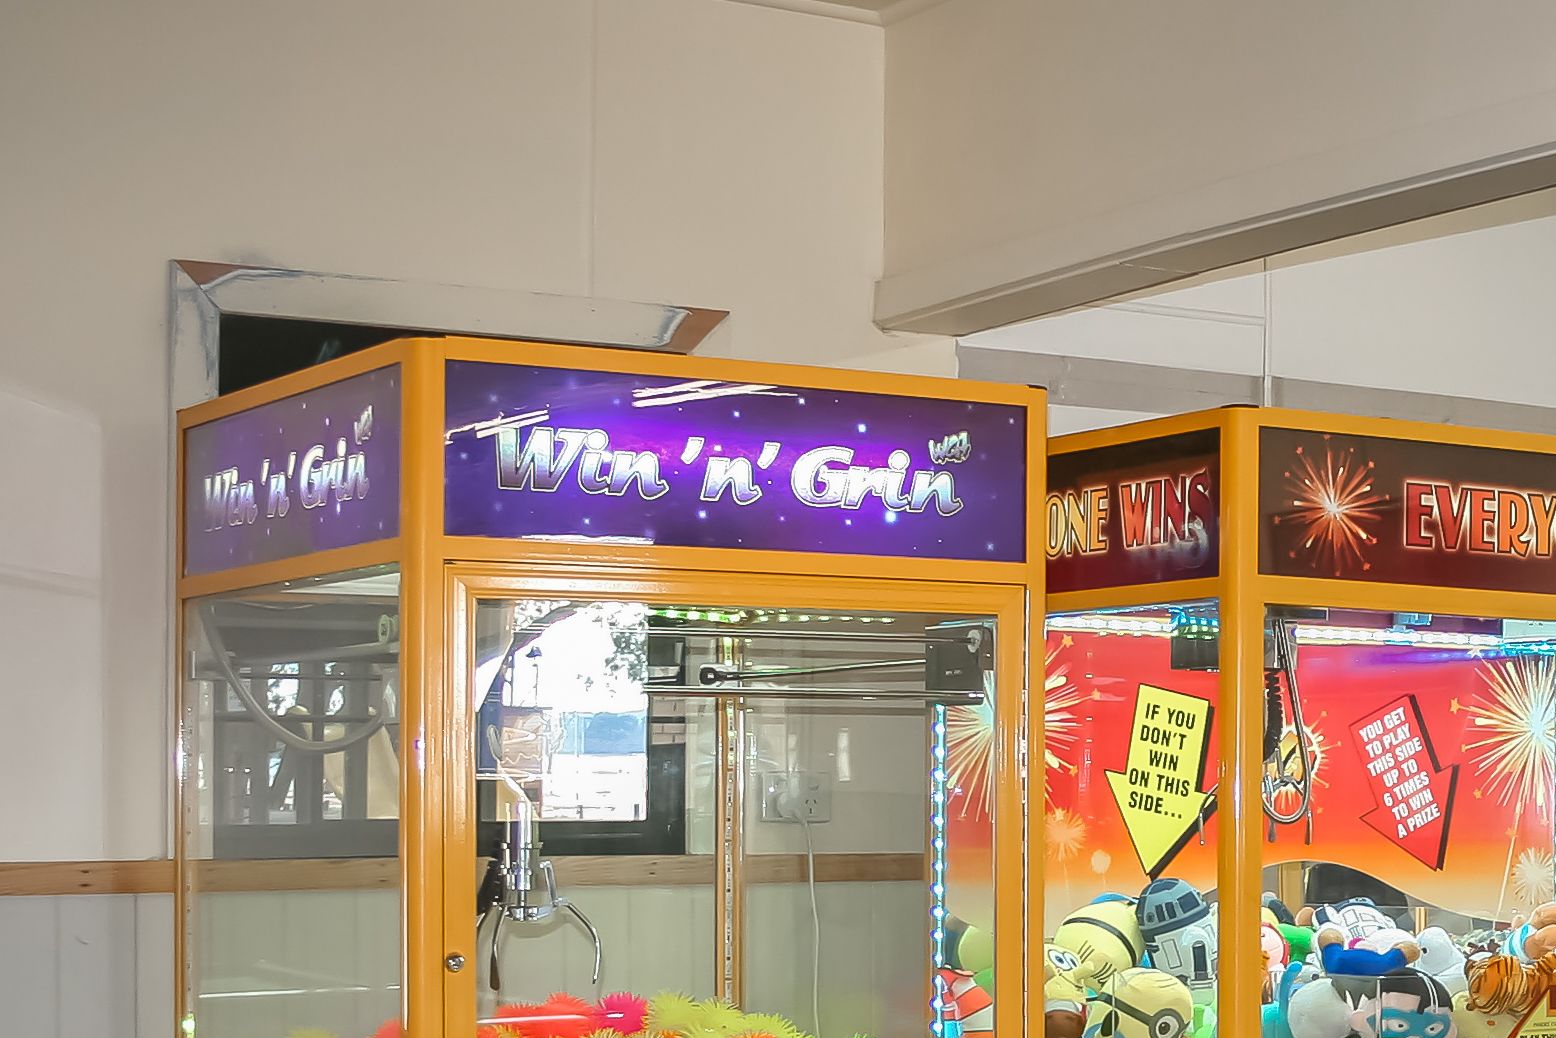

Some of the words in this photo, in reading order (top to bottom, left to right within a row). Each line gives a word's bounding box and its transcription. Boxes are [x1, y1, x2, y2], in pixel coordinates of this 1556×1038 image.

[204, 467, 258, 532] Win
[300, 437, 370, 510] Grin
[494, 426, 668, 499] Win
[790, 446, 964, 516] Grin
[1119, 468, 1211, 551] WINS
[1145, 703, 1160, 720] IF
[1167, 707, 1196, 729] YOU
[1359, 719, 1384, 743] YOU
[1383, 706, 1406, 730] GET
[1140, 724, 1187, 750] DON'T
[1365, 740, 1383, 758] TO
[1382, 722, 1411, 750] PLAY
[1149, 749, 1179, 772] WIN
[1366, 752, 1395, 777] THIS
[1394, 736, 1423, 762] SIDE
[1382, 768, 1399, 788] UP
[1400, 758, 1418, 777] TO
[1129, 768, 1150, 788] ON
[1156, 774, 1190, 797] THIS
[1383, 792, 1394, 807] 6
[1392, 771, 1430, 801] TIMES
[1128, 791, 1182, 819] SIDE...
[1391, 802, 1409, 821] TO
[1408, 788, 1434, 811] WIN
[1397, 823, 1408, 839] A
[1406, 802, 1441, 832] PRIZE
